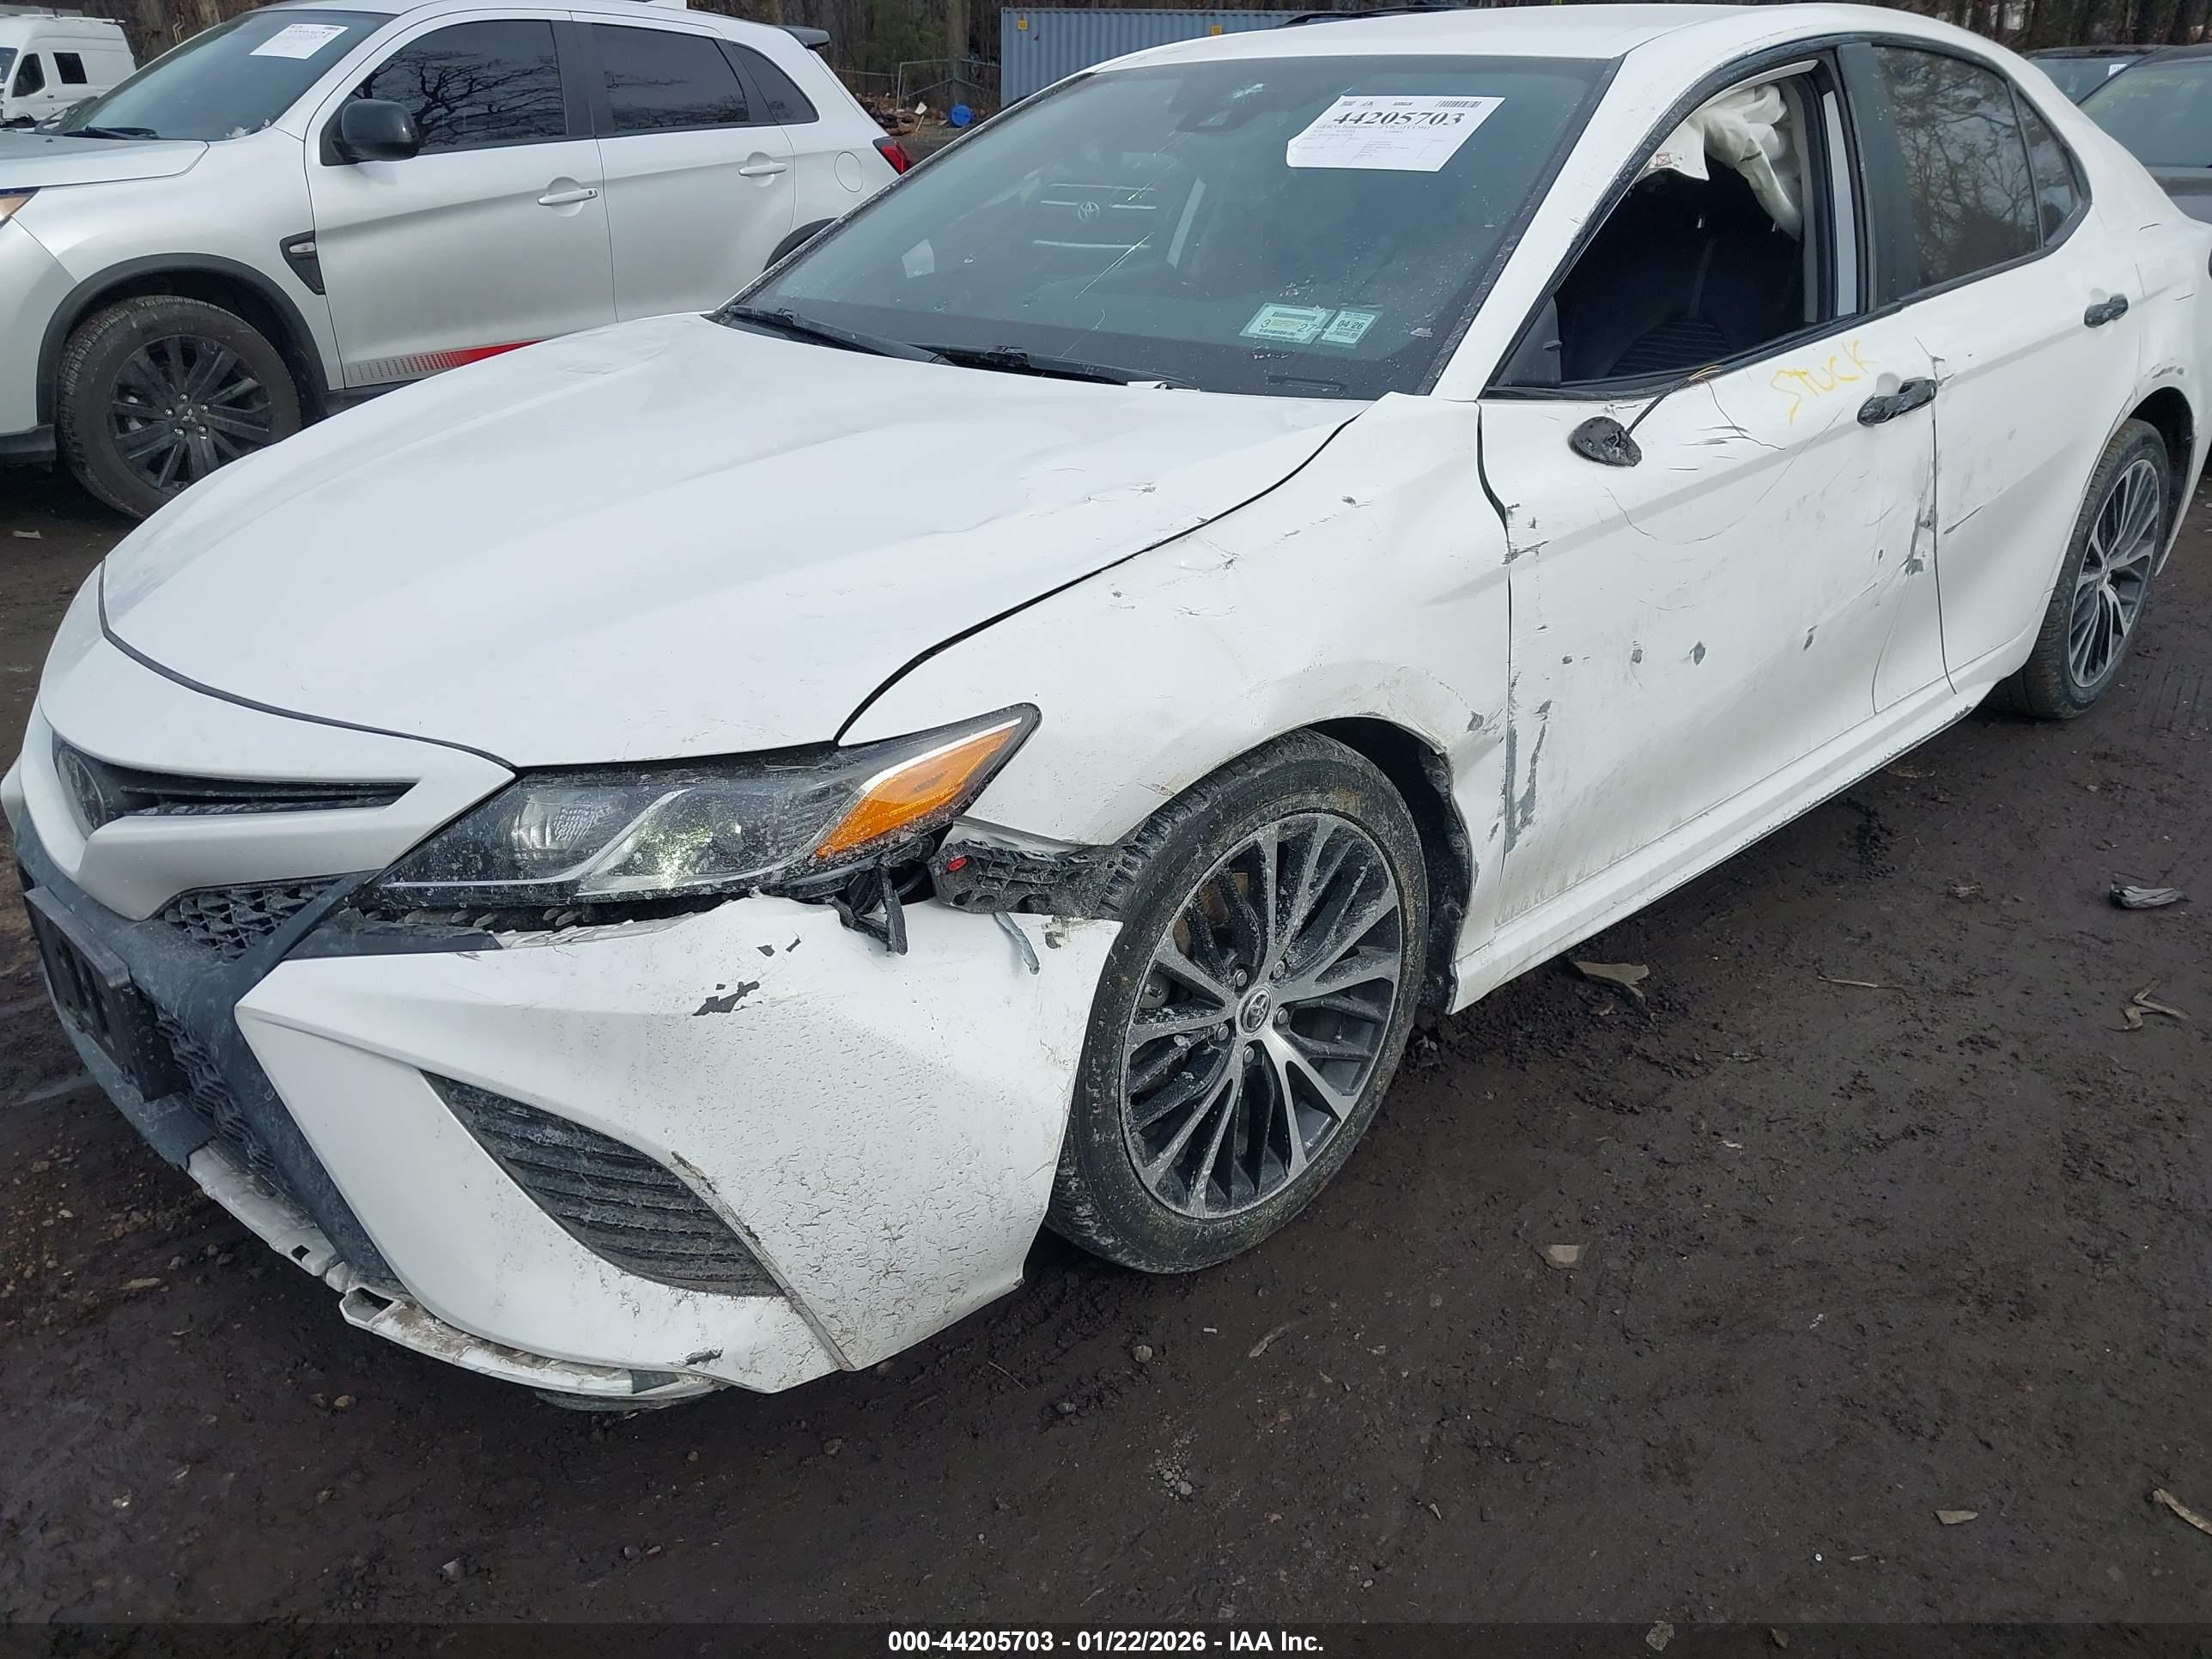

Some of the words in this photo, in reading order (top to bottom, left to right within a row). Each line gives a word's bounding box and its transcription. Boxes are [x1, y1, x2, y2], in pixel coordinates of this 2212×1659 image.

[1333, 112, 1467, 125] 44205703
[1261, 319, 1271, 328] 3
[1297, 323, 1317, 332] 27
[1771, 339, 1879, 426] STUCK
